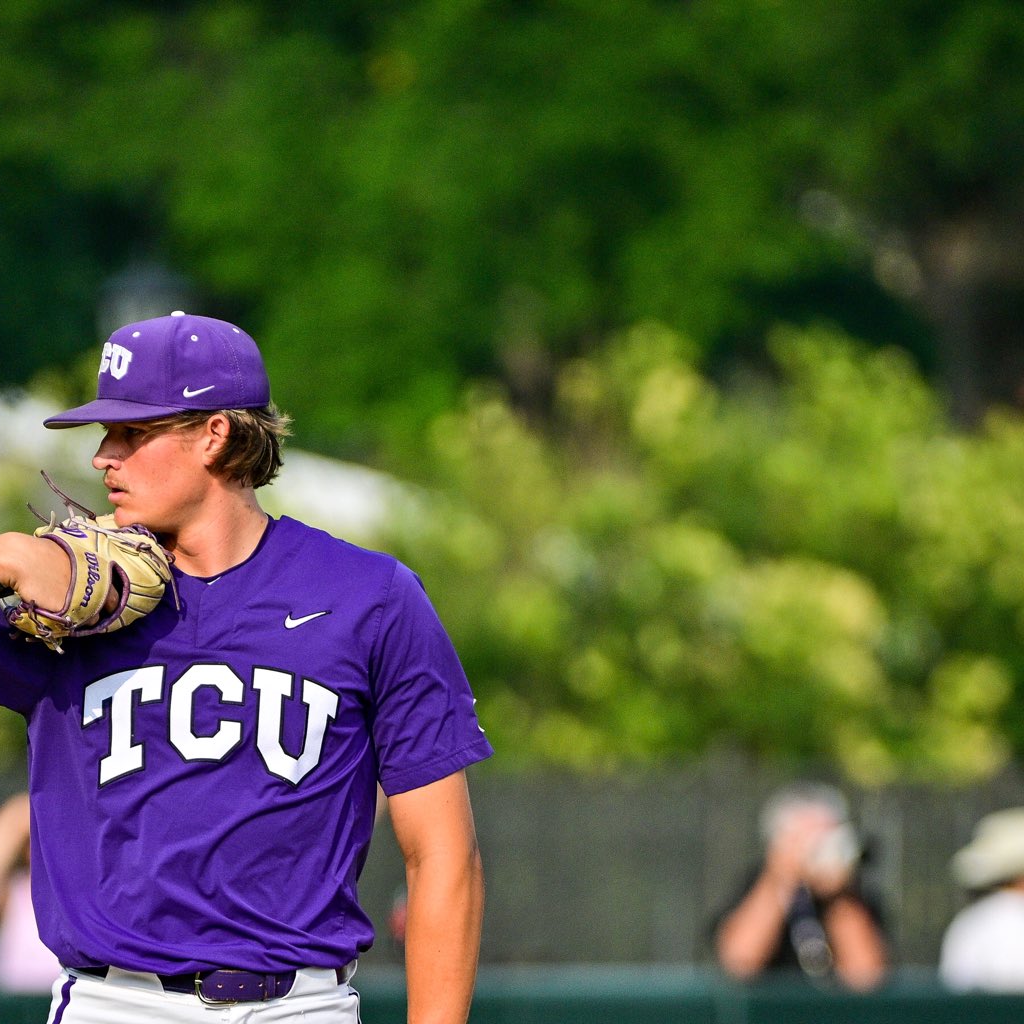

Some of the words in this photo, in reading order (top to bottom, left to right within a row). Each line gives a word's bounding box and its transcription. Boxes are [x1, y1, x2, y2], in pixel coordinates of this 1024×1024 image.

[98, 342, 133, 380] CU
[80, 551, 101, 608] Wilson
[81, 662, 339, 788] TCU
